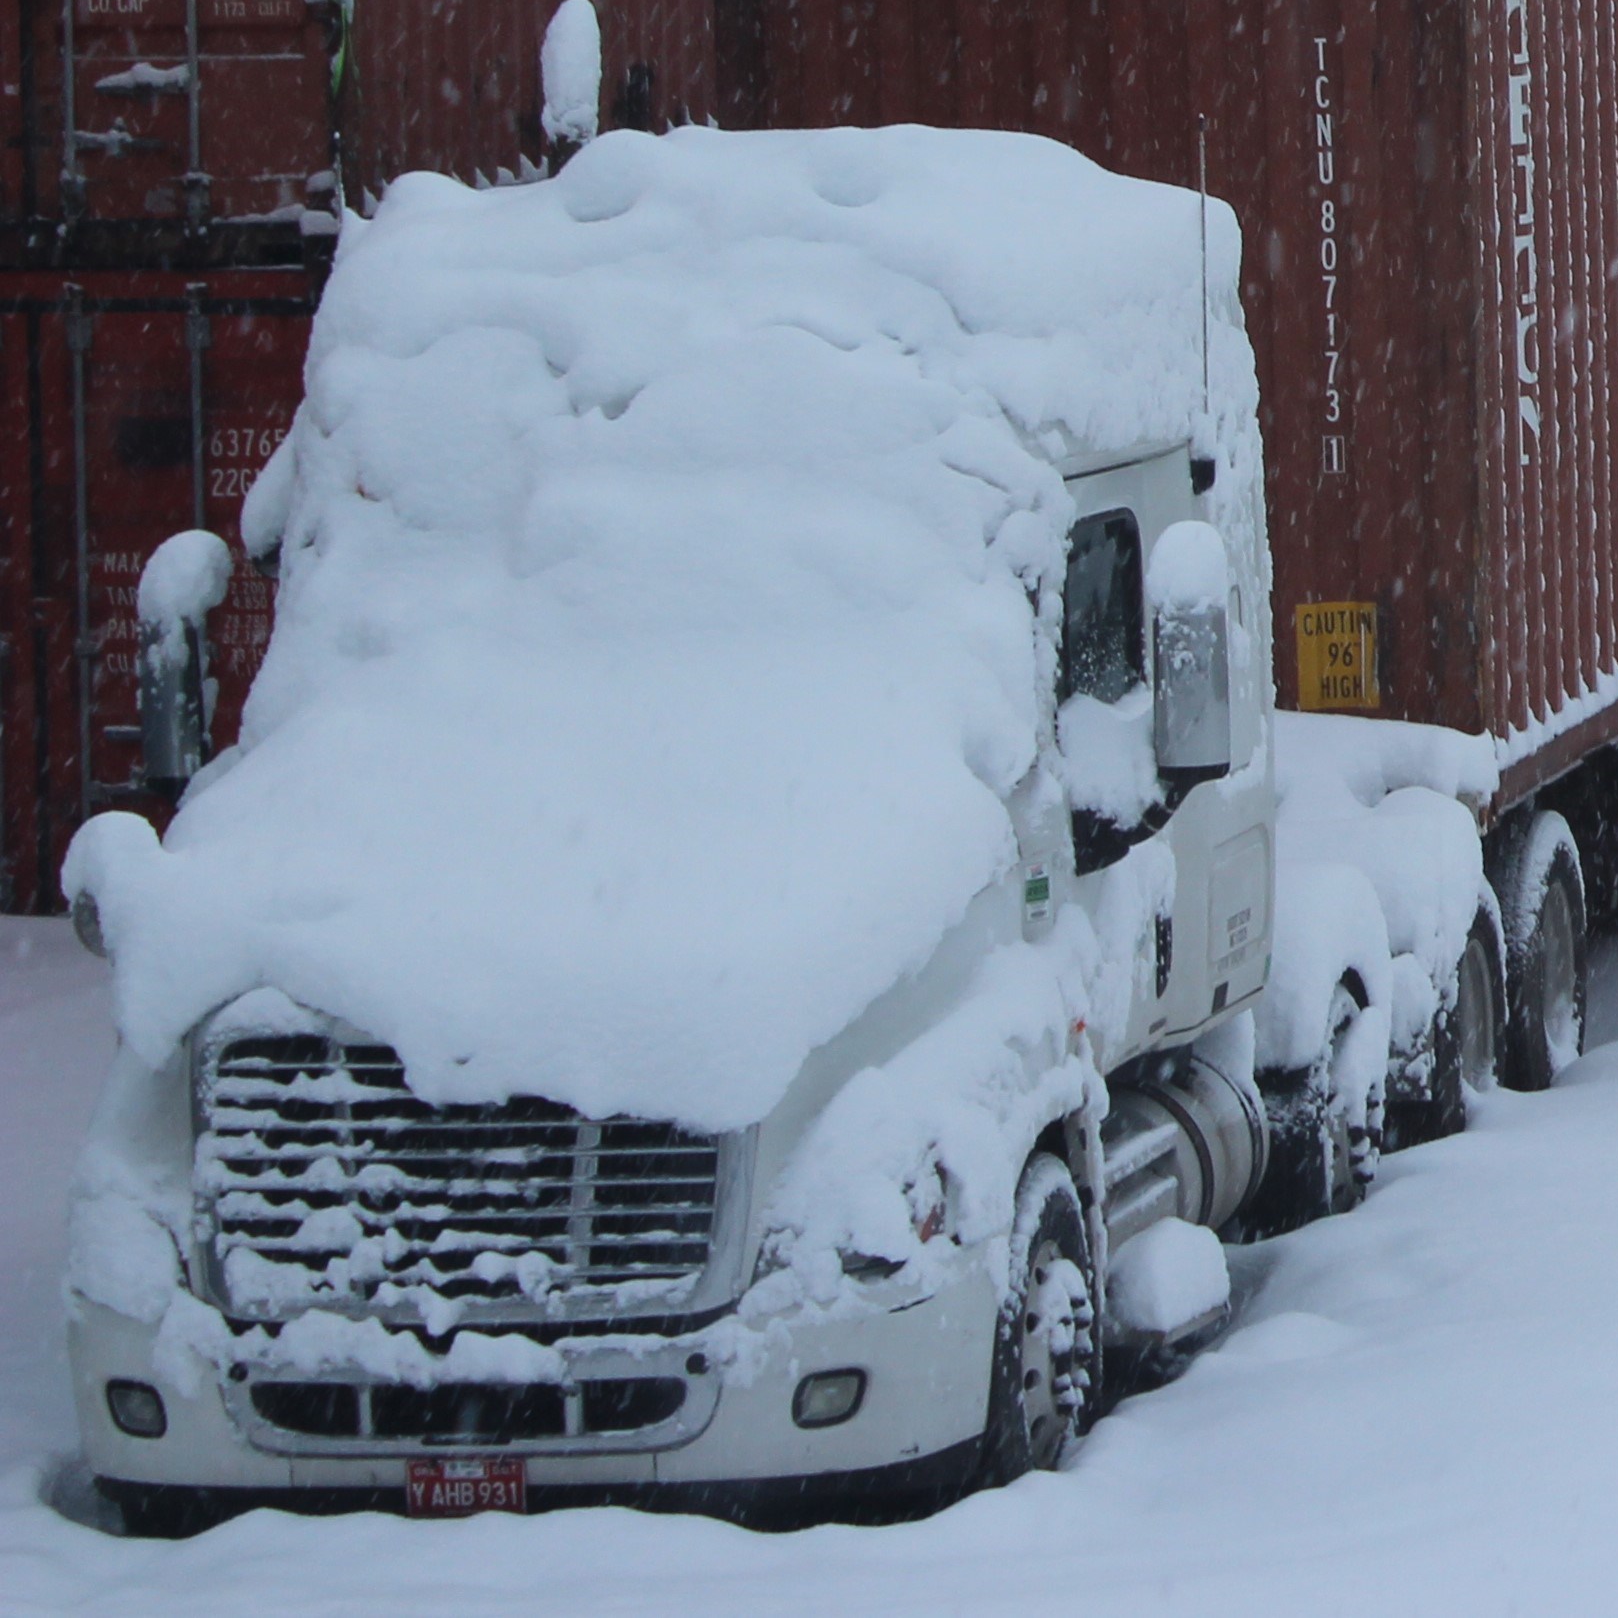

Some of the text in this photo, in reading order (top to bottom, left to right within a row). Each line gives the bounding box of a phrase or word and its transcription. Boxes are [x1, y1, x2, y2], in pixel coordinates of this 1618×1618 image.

[1314, 37, 1334, 184] TCNU
[1320, 200, 1341, 423] 807173
[211, 468, 262, 497] 22G
[104, 552, 141, 573] MAX
[1321, 674, 1365, 700] HIGH
